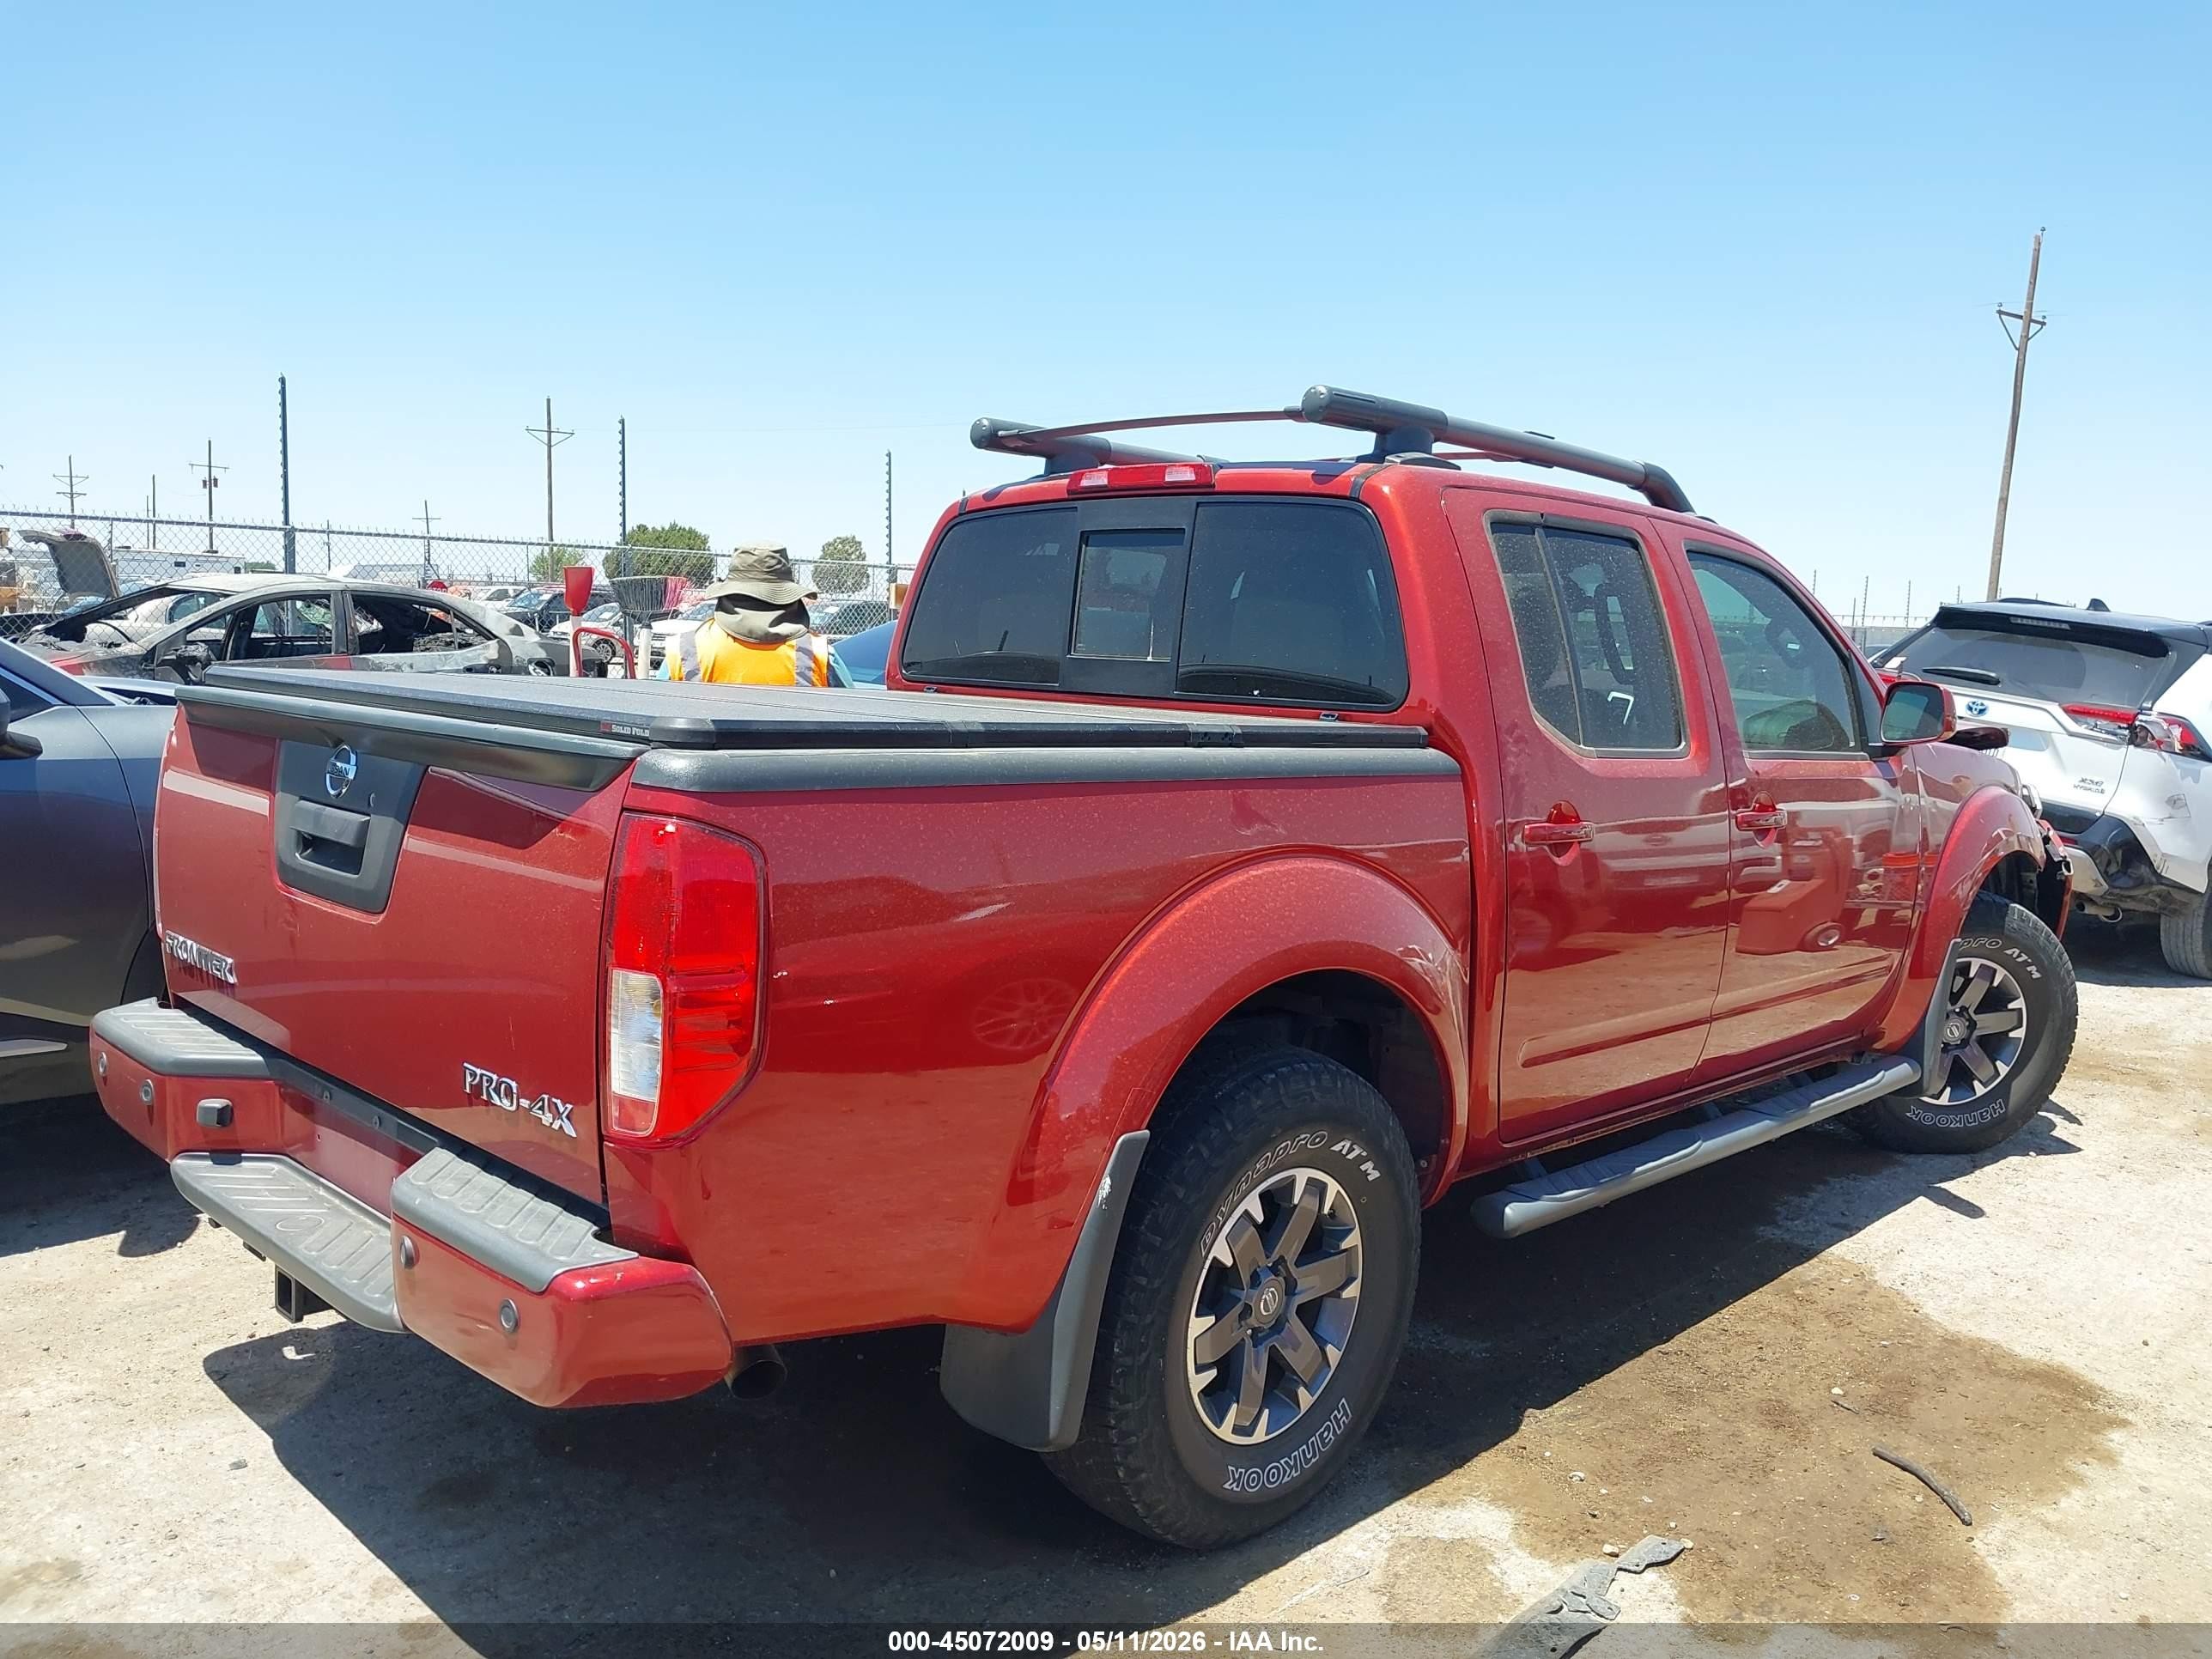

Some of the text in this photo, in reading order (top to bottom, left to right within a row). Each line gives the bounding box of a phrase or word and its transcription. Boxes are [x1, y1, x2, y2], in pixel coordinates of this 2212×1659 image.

[611, 724, 650, 737] SOLID FOLD
[165, 930, 238, 985] FRONTIER
[462, 1061, 578, 1138] PRO-4X
[1200, 1130, 1328, 1256] Dynapro
